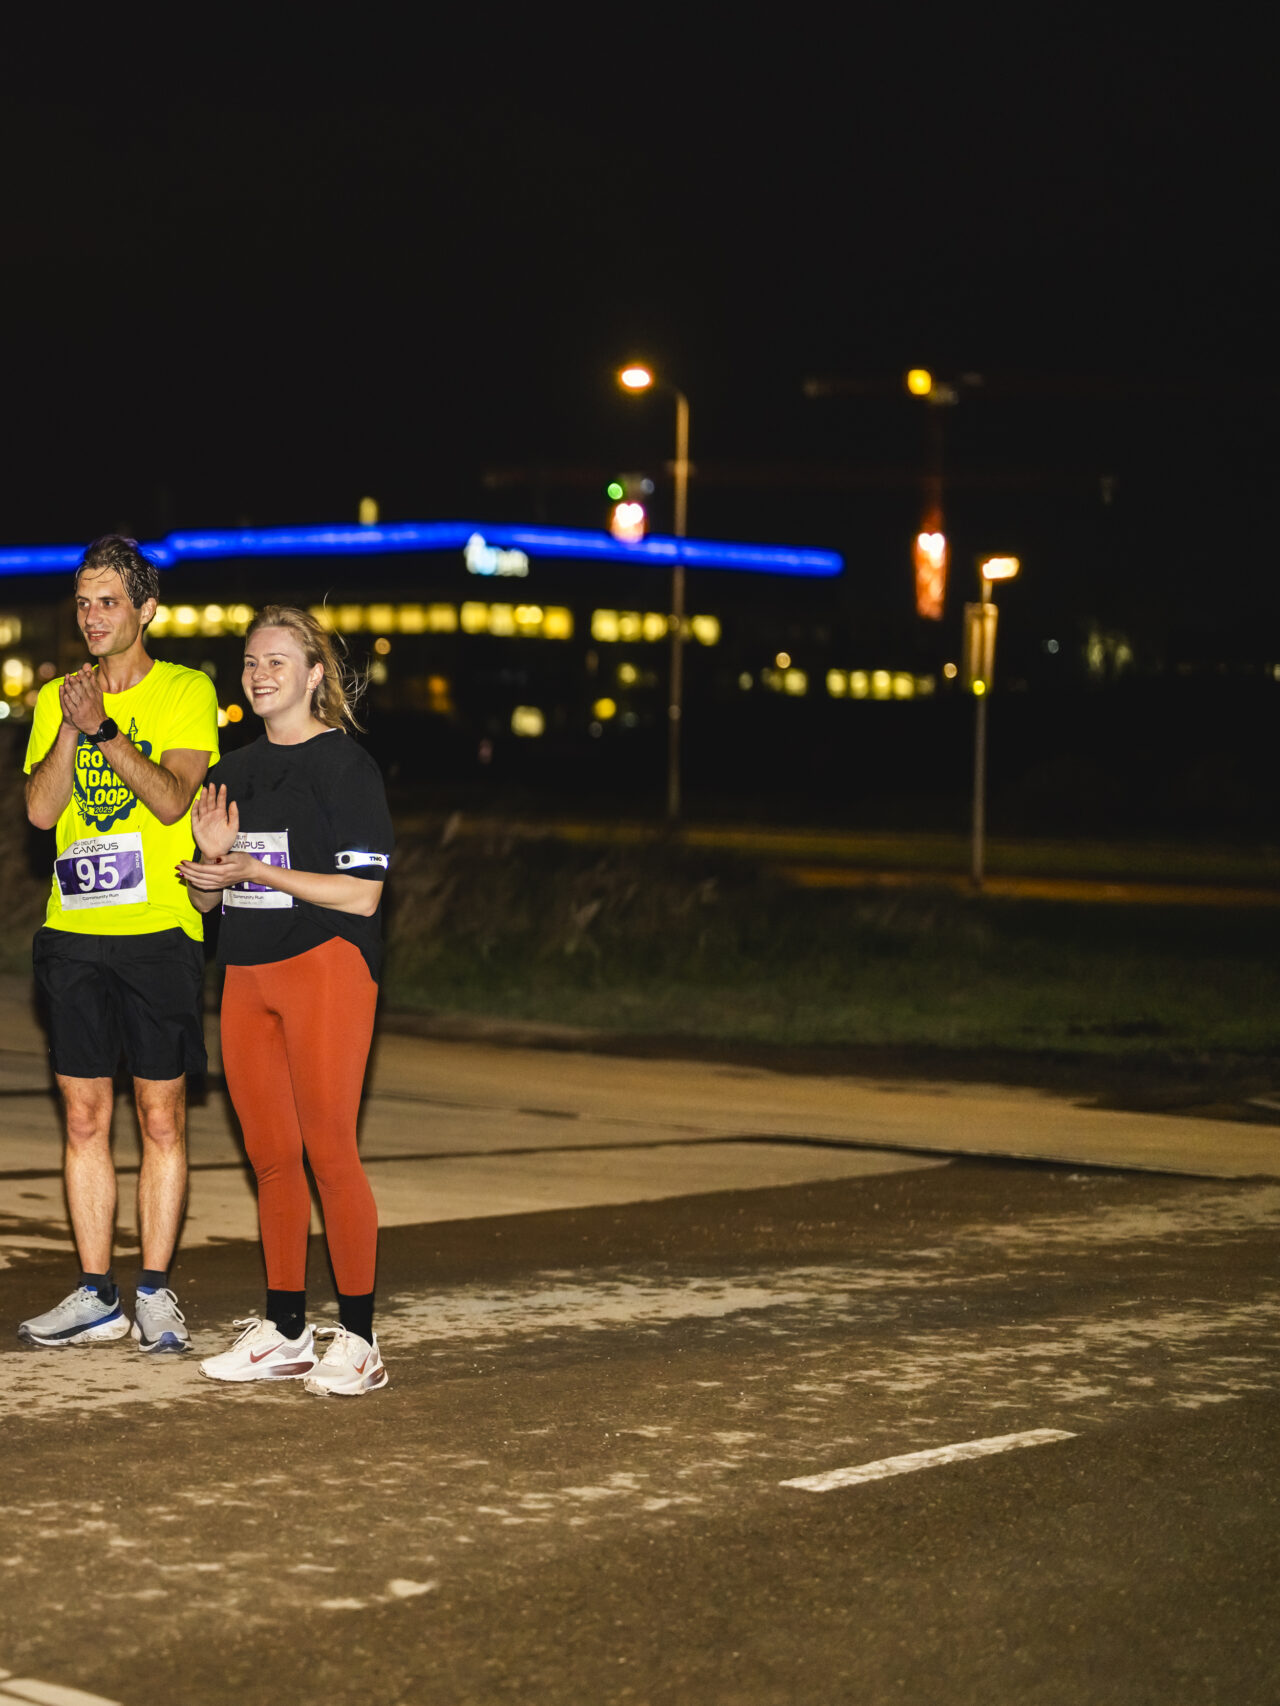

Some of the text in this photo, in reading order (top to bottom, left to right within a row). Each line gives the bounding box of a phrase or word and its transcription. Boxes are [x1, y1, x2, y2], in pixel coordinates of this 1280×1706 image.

[86, 788, 129, 805] LOOP
[94, 806, 113, 814] 2025
[72, 842, 119, 855] CAMPUS
[231, 841, 266, 850] AMPUS
[76, 855, 119, 892] 95
